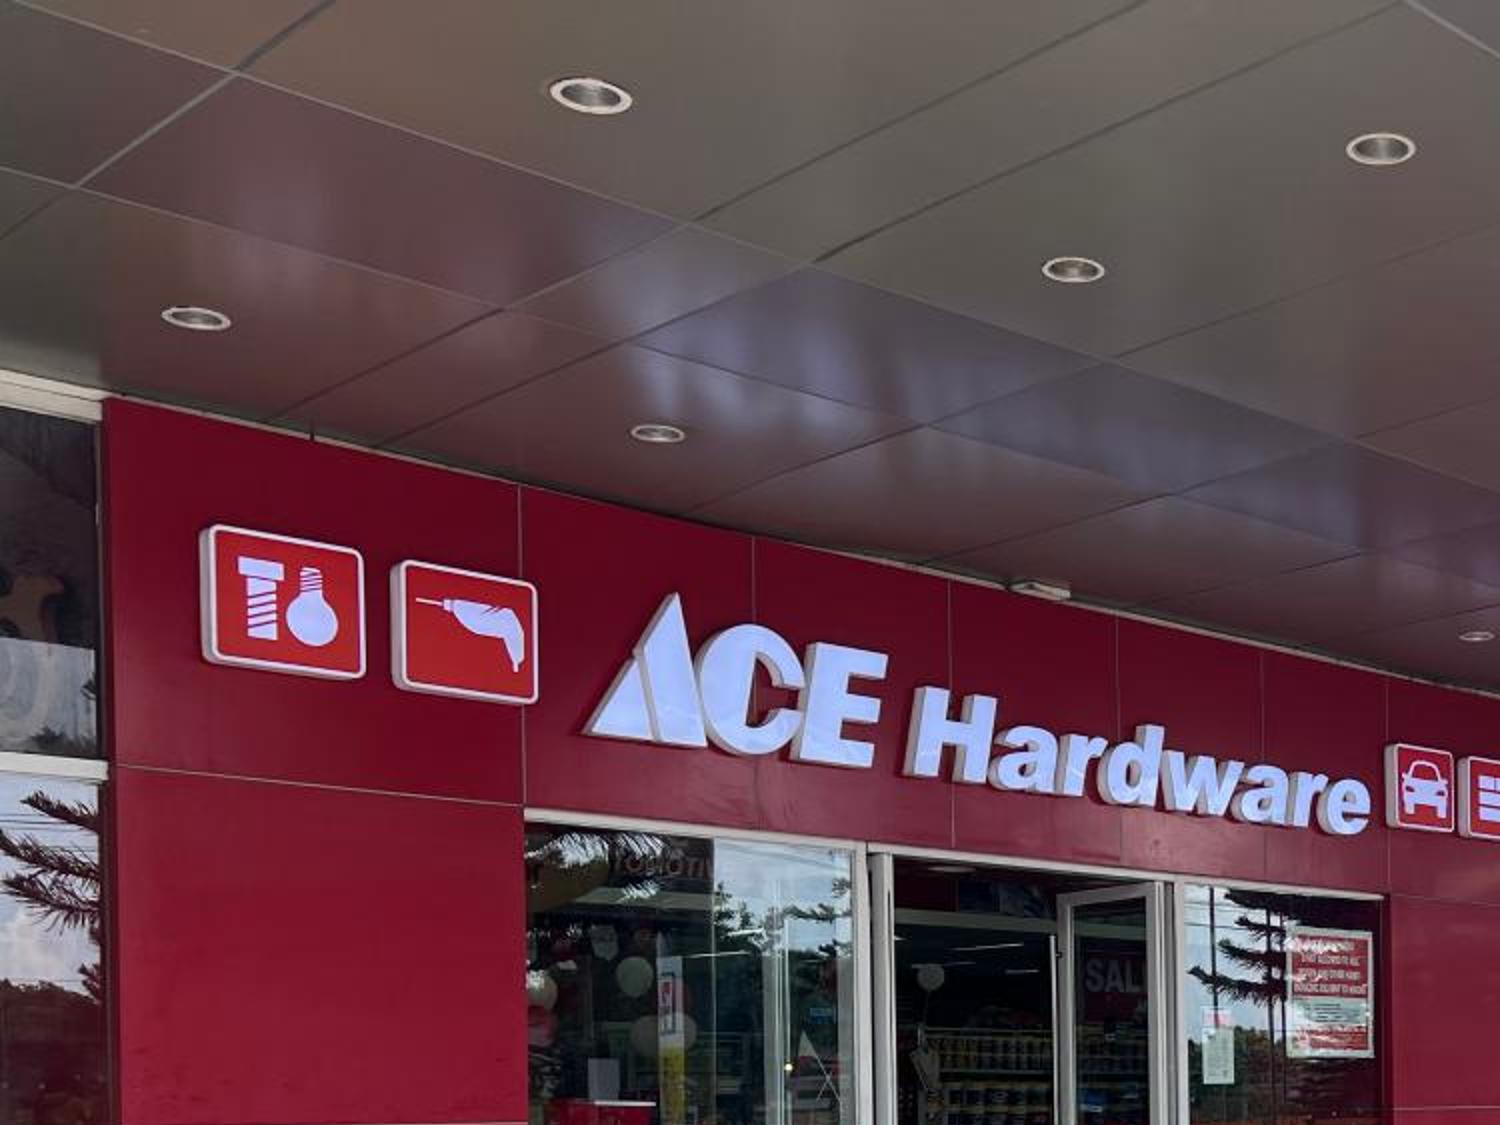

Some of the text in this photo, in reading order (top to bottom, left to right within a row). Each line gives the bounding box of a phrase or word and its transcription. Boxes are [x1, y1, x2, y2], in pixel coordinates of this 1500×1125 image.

[583, 591, 1372, 837] ACE Hardware
[1085, 958, 1146, 992] SAL
